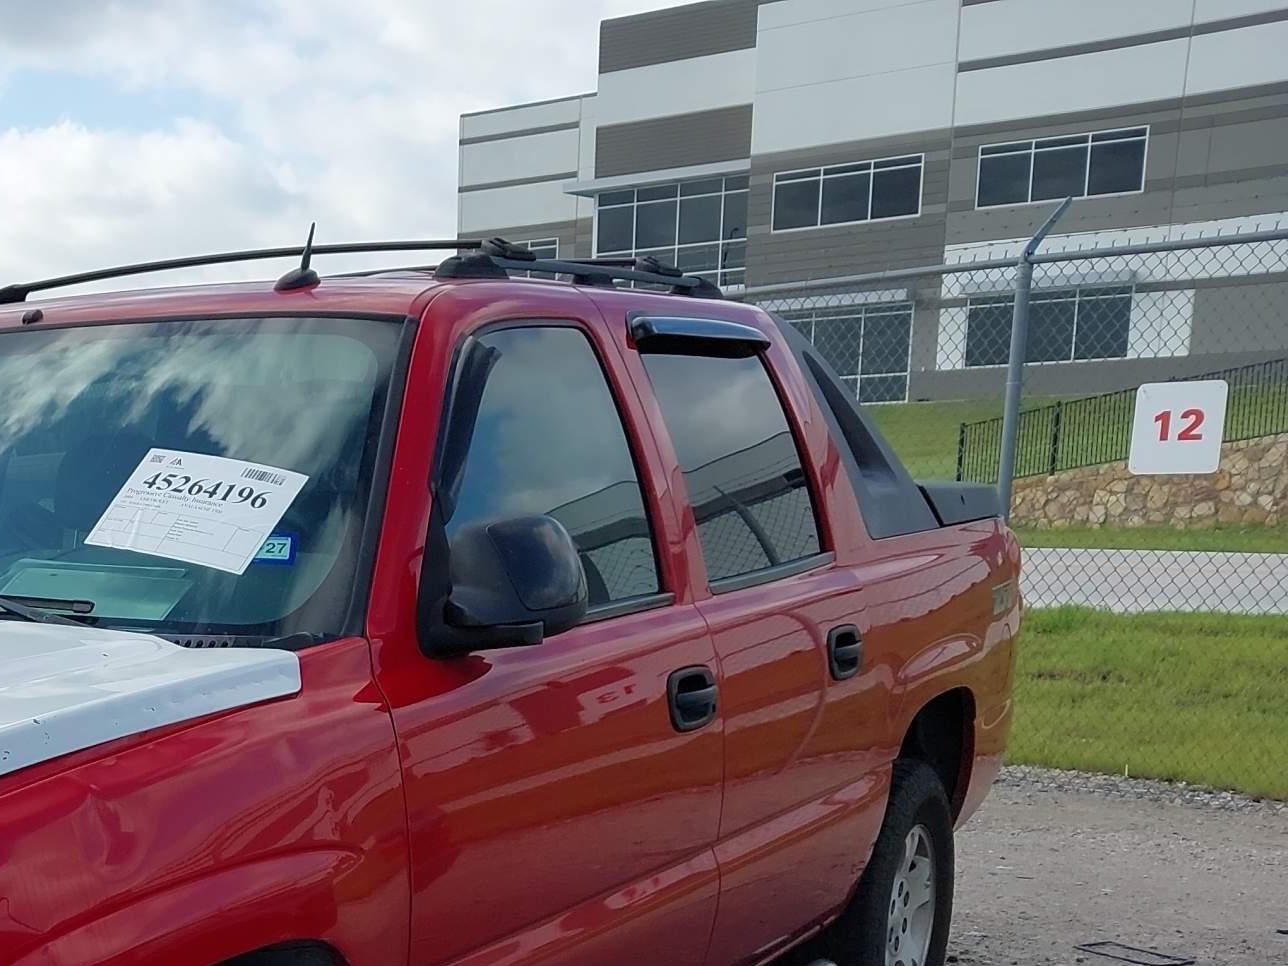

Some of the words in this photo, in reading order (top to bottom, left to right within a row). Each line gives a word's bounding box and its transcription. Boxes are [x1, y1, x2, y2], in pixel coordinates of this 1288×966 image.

[1154, 408, 1205, 441] 12
[127, 487, 162, 498] Progressive
[163, 492, 189, 502] Casualty
[191, 497, 223, 507] Insurance
[143, 471, 273, 509] 45264196
[265, 542, 287, 554] 27
